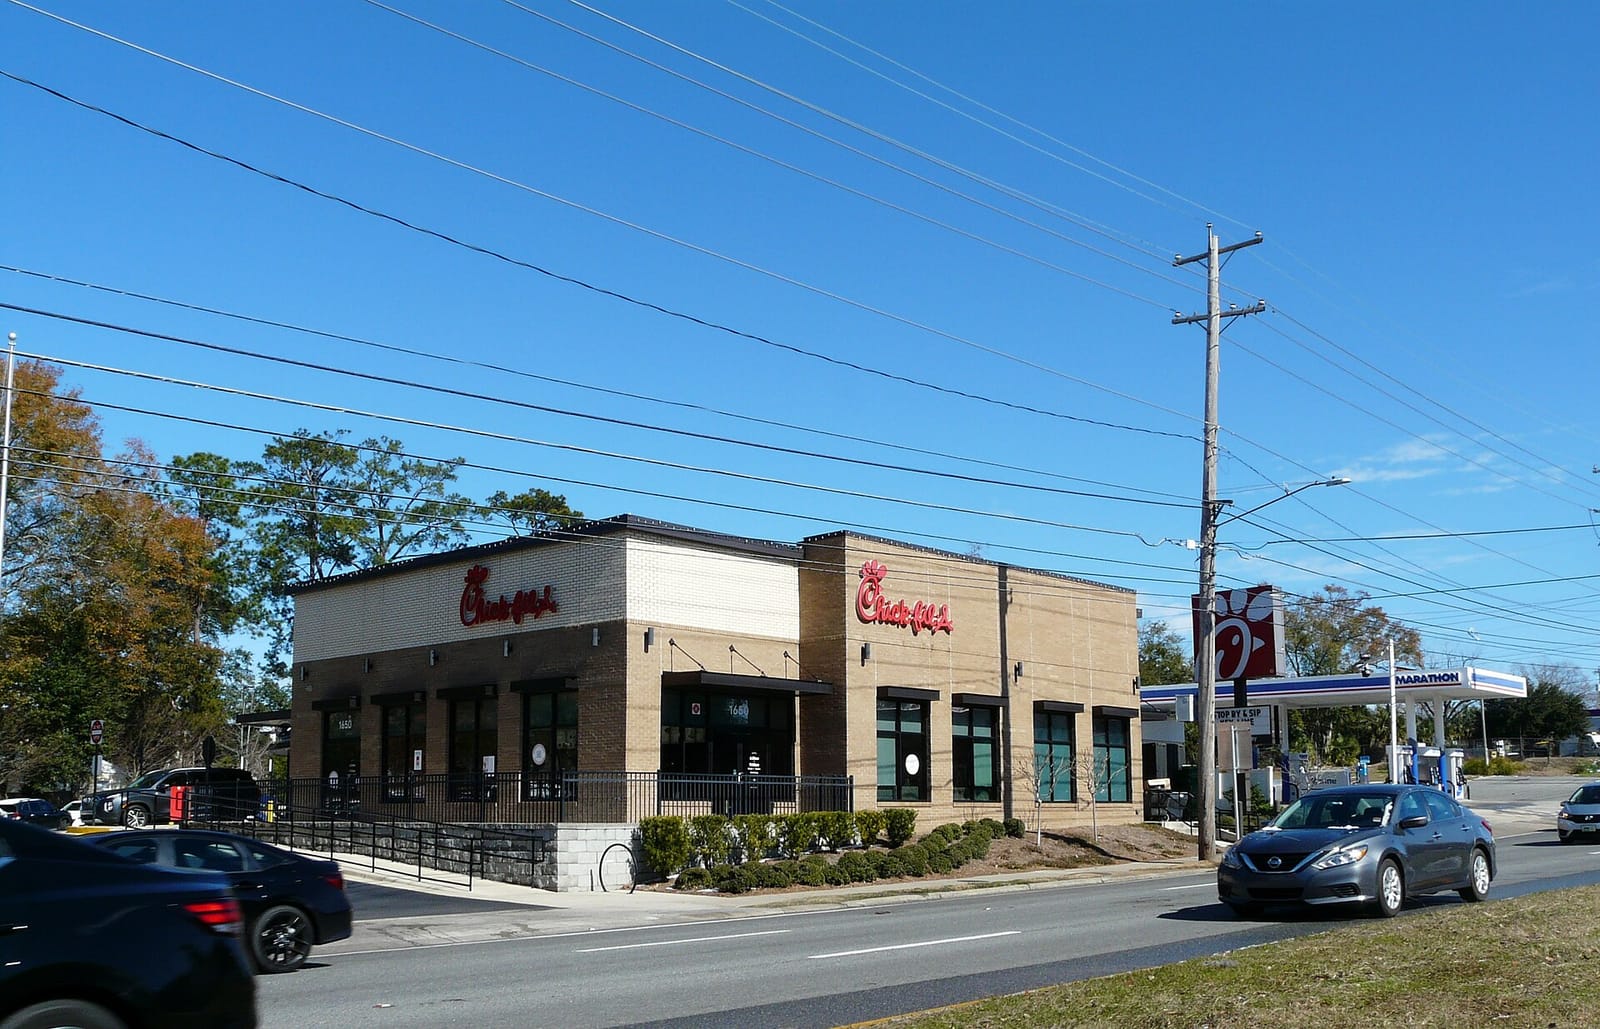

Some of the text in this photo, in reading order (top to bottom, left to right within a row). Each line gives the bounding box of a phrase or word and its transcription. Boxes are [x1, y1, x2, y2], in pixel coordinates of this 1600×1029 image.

[857, 574, 954, 633] Chick-fil-A
[1395, 672, 1459, 685] MARATHON
[1231, 710, 1241, 718] BY
[1248, 709, 1262, 717] SIP
